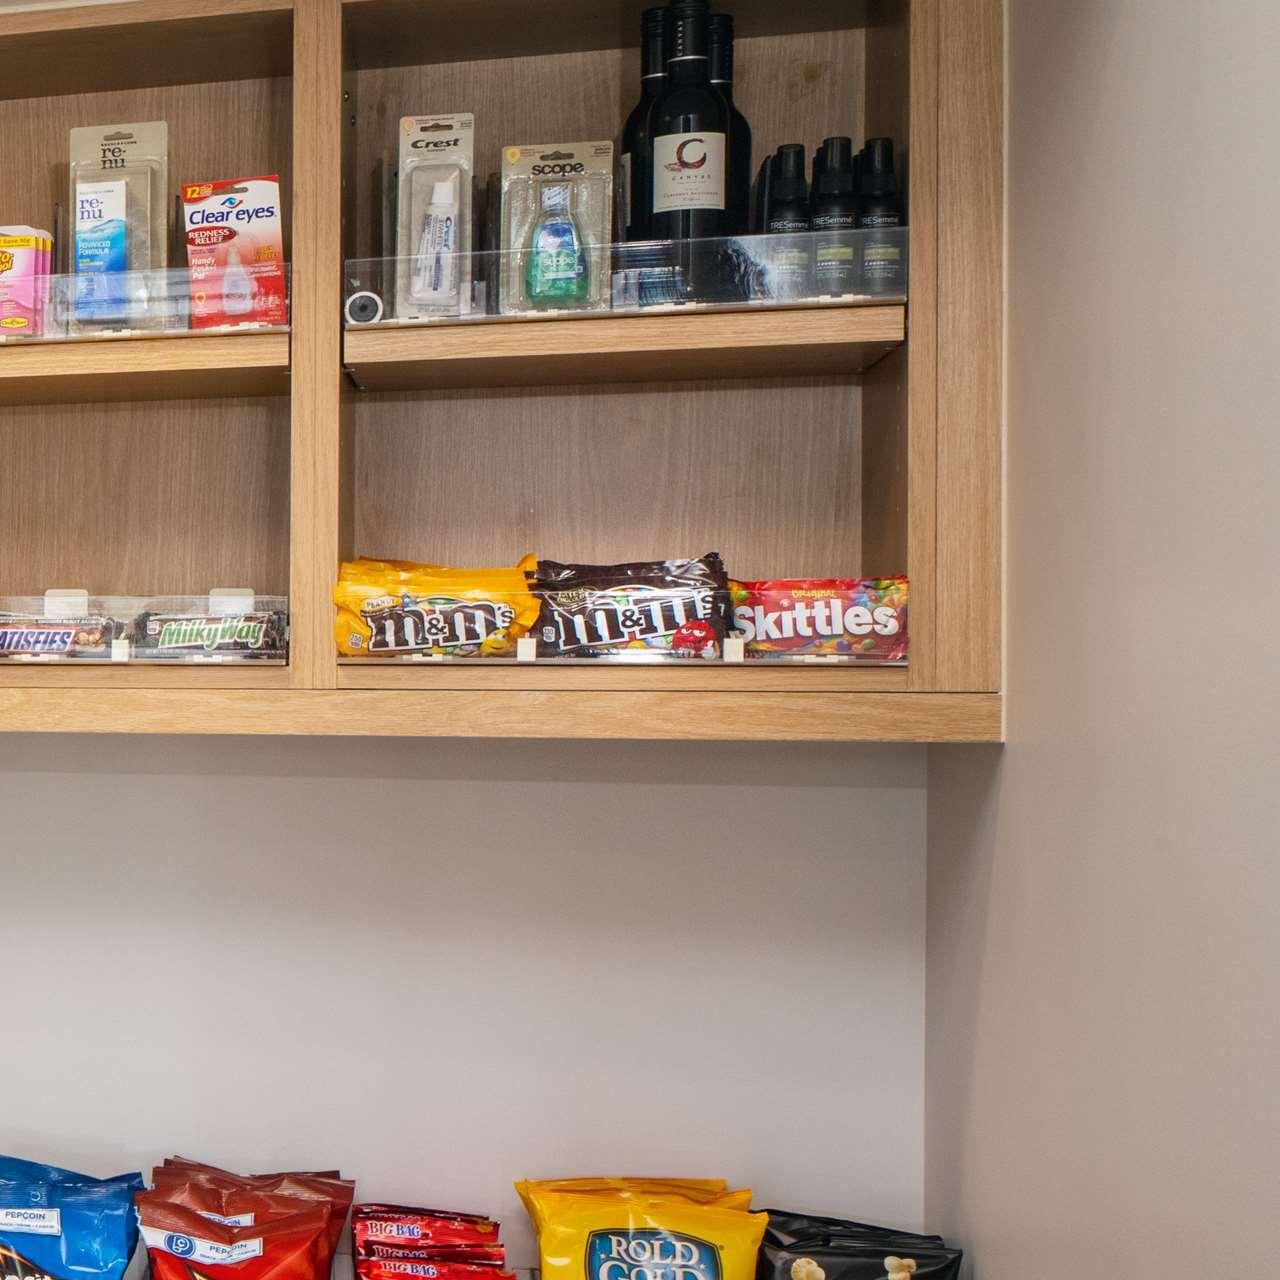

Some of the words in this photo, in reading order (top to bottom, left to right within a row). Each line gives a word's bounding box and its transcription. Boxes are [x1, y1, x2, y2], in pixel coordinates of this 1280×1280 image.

[411, 138, 460, 149] Crest
[101, 158, 125, 169] nu
[532, 162, 584, 176] scope
[79, 209, 104, 220] nu
[189, 209, 230, 225] Clear
[235, 206, 275, 223] eyes
[189, 229, 230, 239] REDNESS
[195, 236, 224, 245] RELIEF
[733, 601, 900, 640] Skittles
[5, 1211, 46, 1220] PEPCOIN
[367, 1221, 394, 1235] BIG
[395, 1223, 421, 1238] BAG
[610, 1235, 700, 1266] ROLD
[381, 1261, 408, 1273] BIG
[408, 1263, 437, 1277] BAG
